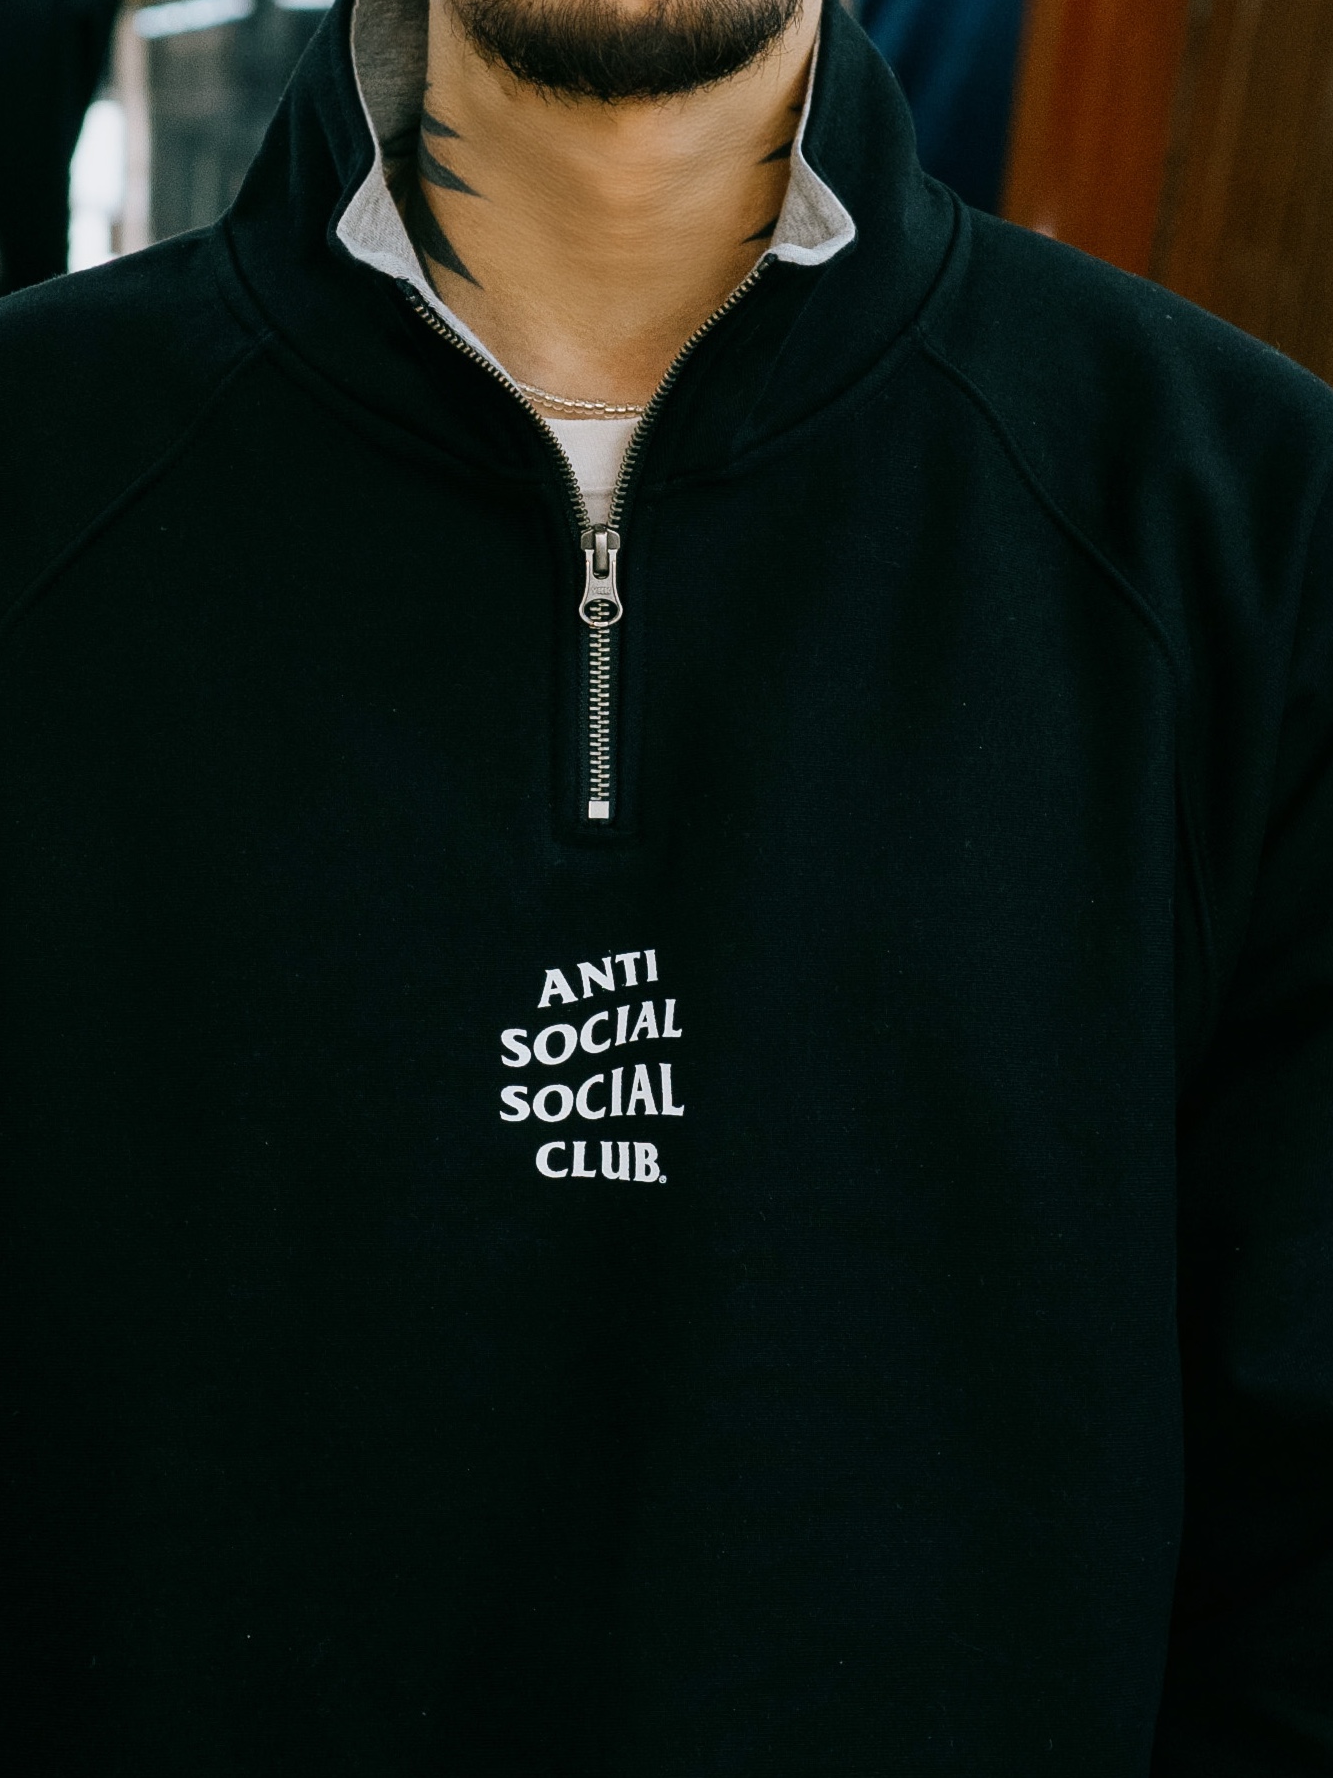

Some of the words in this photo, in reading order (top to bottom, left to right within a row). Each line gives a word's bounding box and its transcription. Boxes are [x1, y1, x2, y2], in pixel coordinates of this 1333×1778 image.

[537, 949, 659, 1008] ANTI
[501, 998, 683, 1068] SOCIAL
[499, 1062, 685, 1123] SOCIAL
